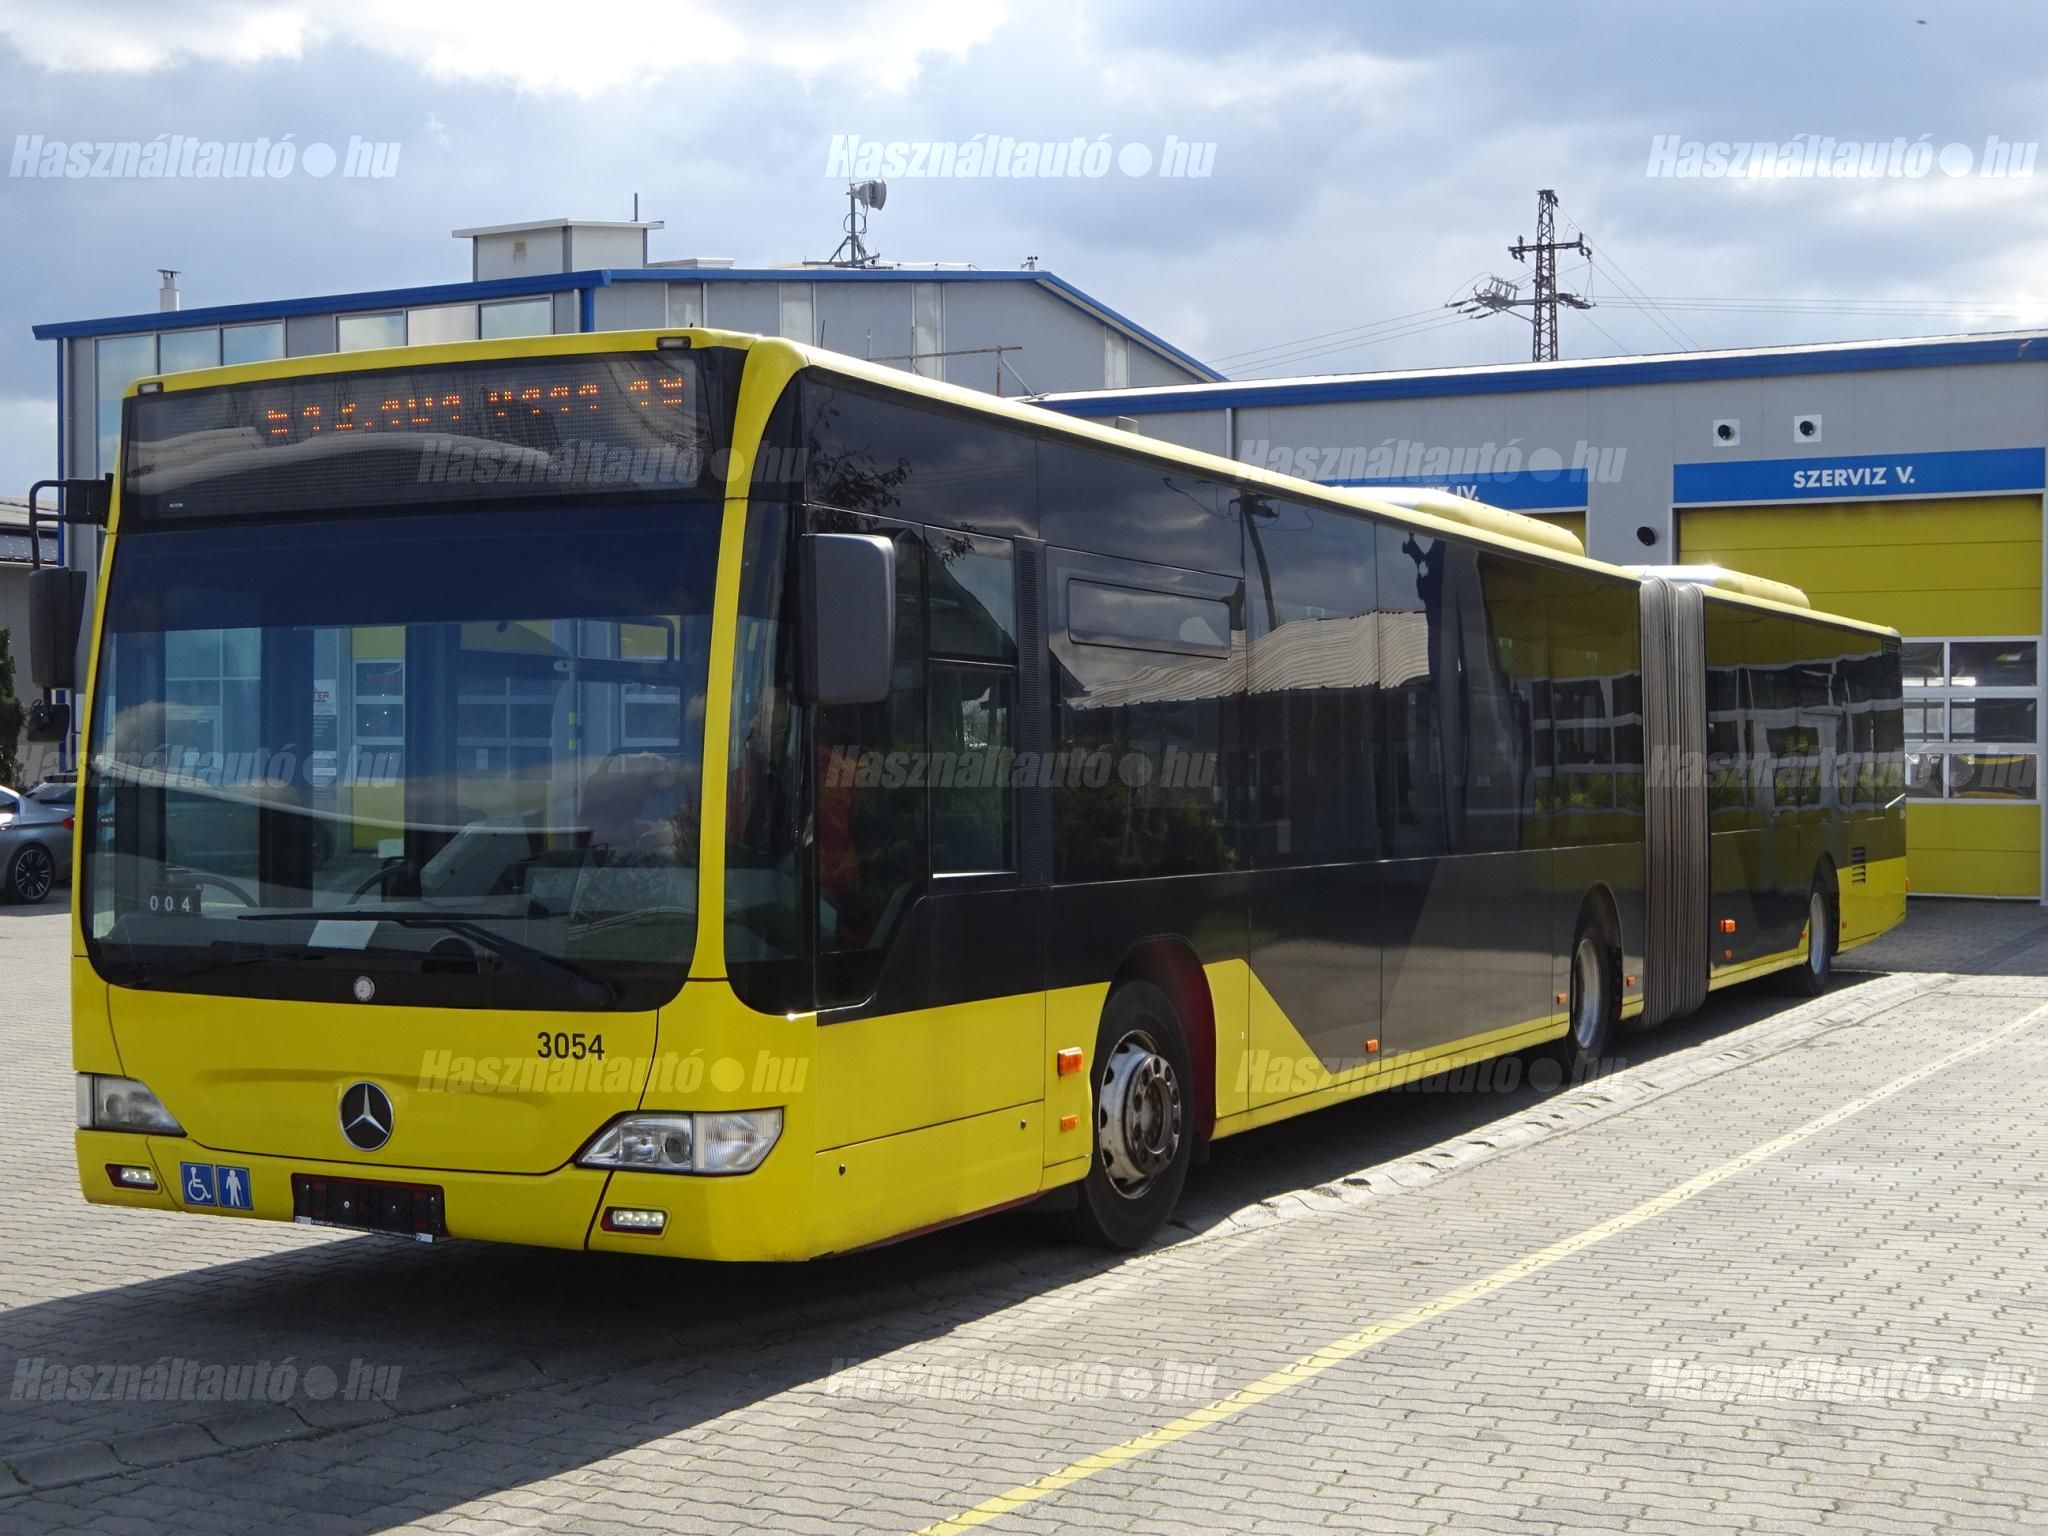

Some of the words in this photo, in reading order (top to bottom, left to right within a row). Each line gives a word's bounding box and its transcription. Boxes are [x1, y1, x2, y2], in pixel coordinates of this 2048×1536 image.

[1793, 467, 1887, 489] SZERVIZ
[1895, 466, 1916, 484] V.
[537, 1031, 605, 1061] 3054
